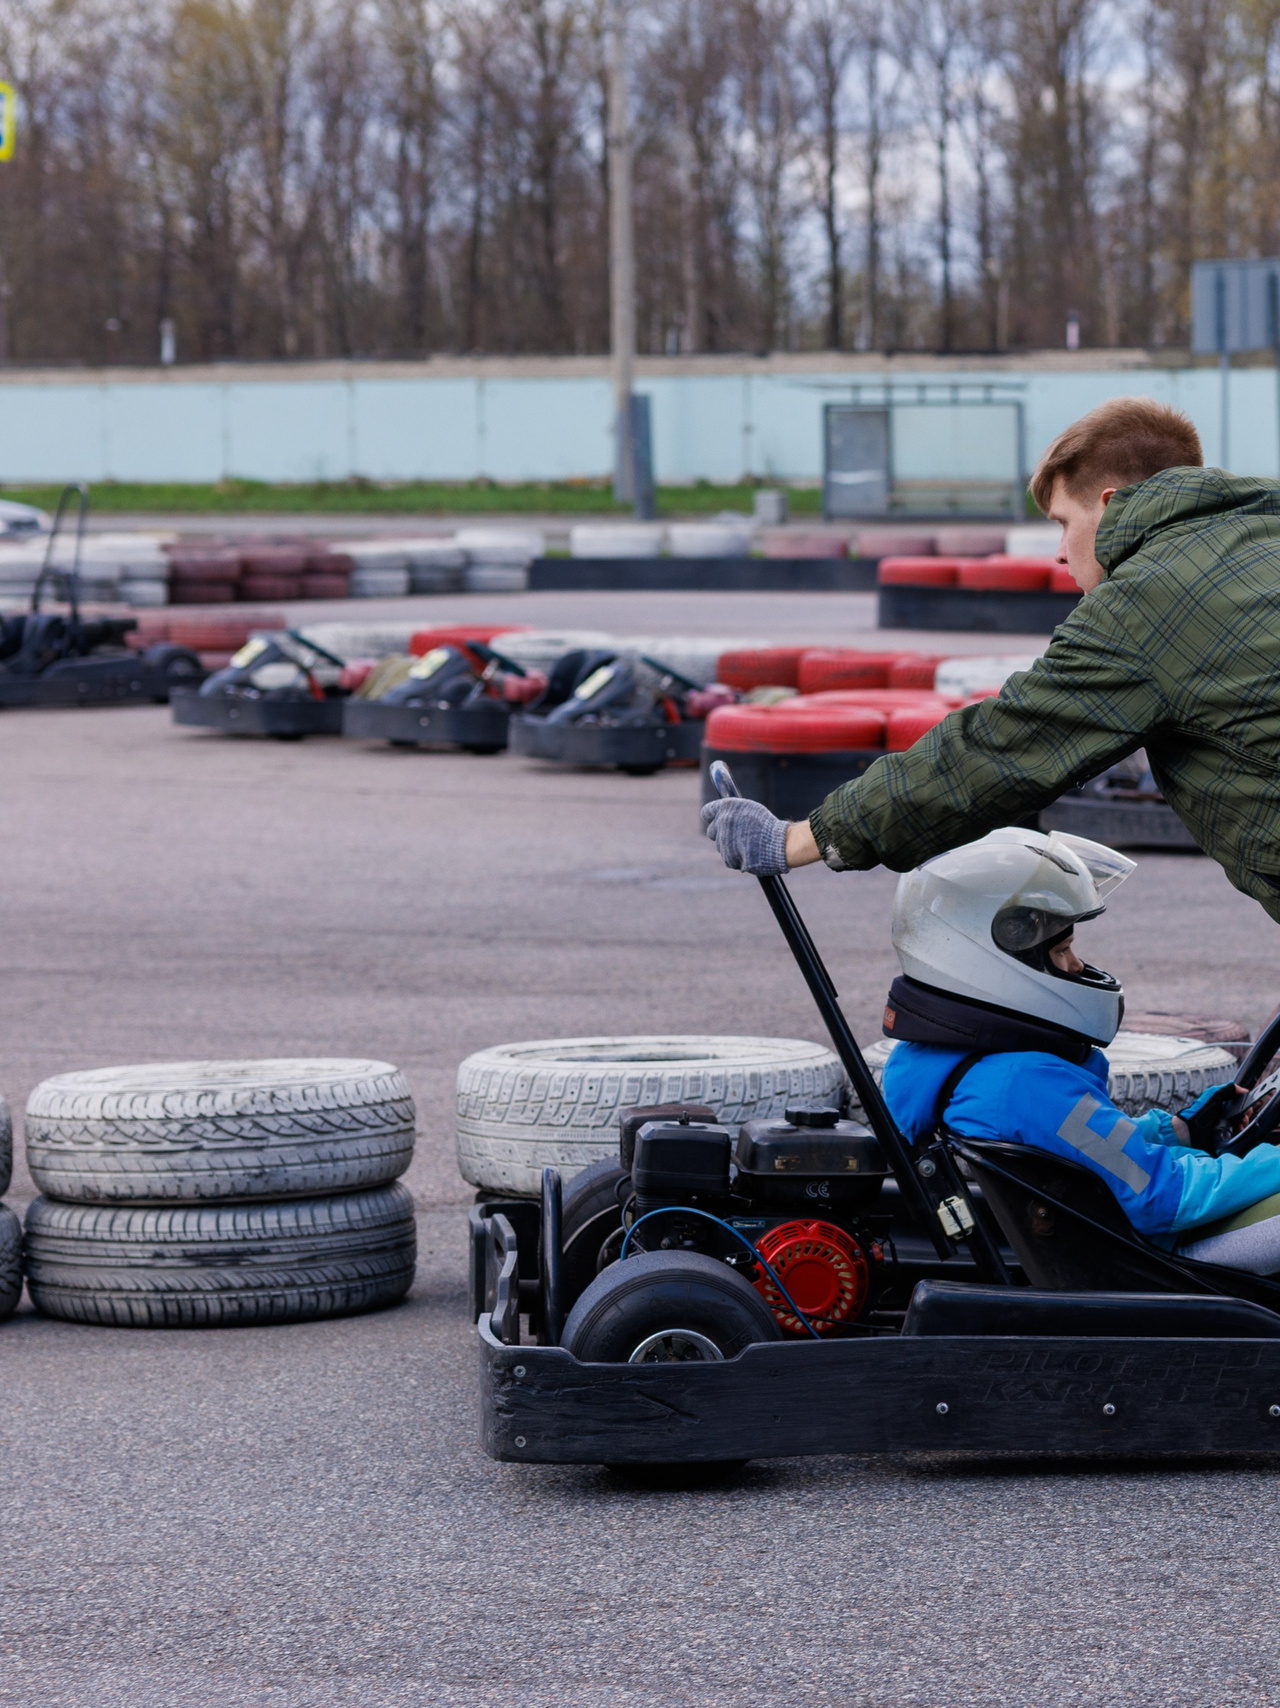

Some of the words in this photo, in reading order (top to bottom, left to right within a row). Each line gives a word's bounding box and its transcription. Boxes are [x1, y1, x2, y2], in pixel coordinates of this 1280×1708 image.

[1057, 1092, 1151, 1195] F
[805, 1180, 830, 1198] CE
[982, 1351, 1136, 1376] PILOT
[976, 1380, 1147, 1403] KART
